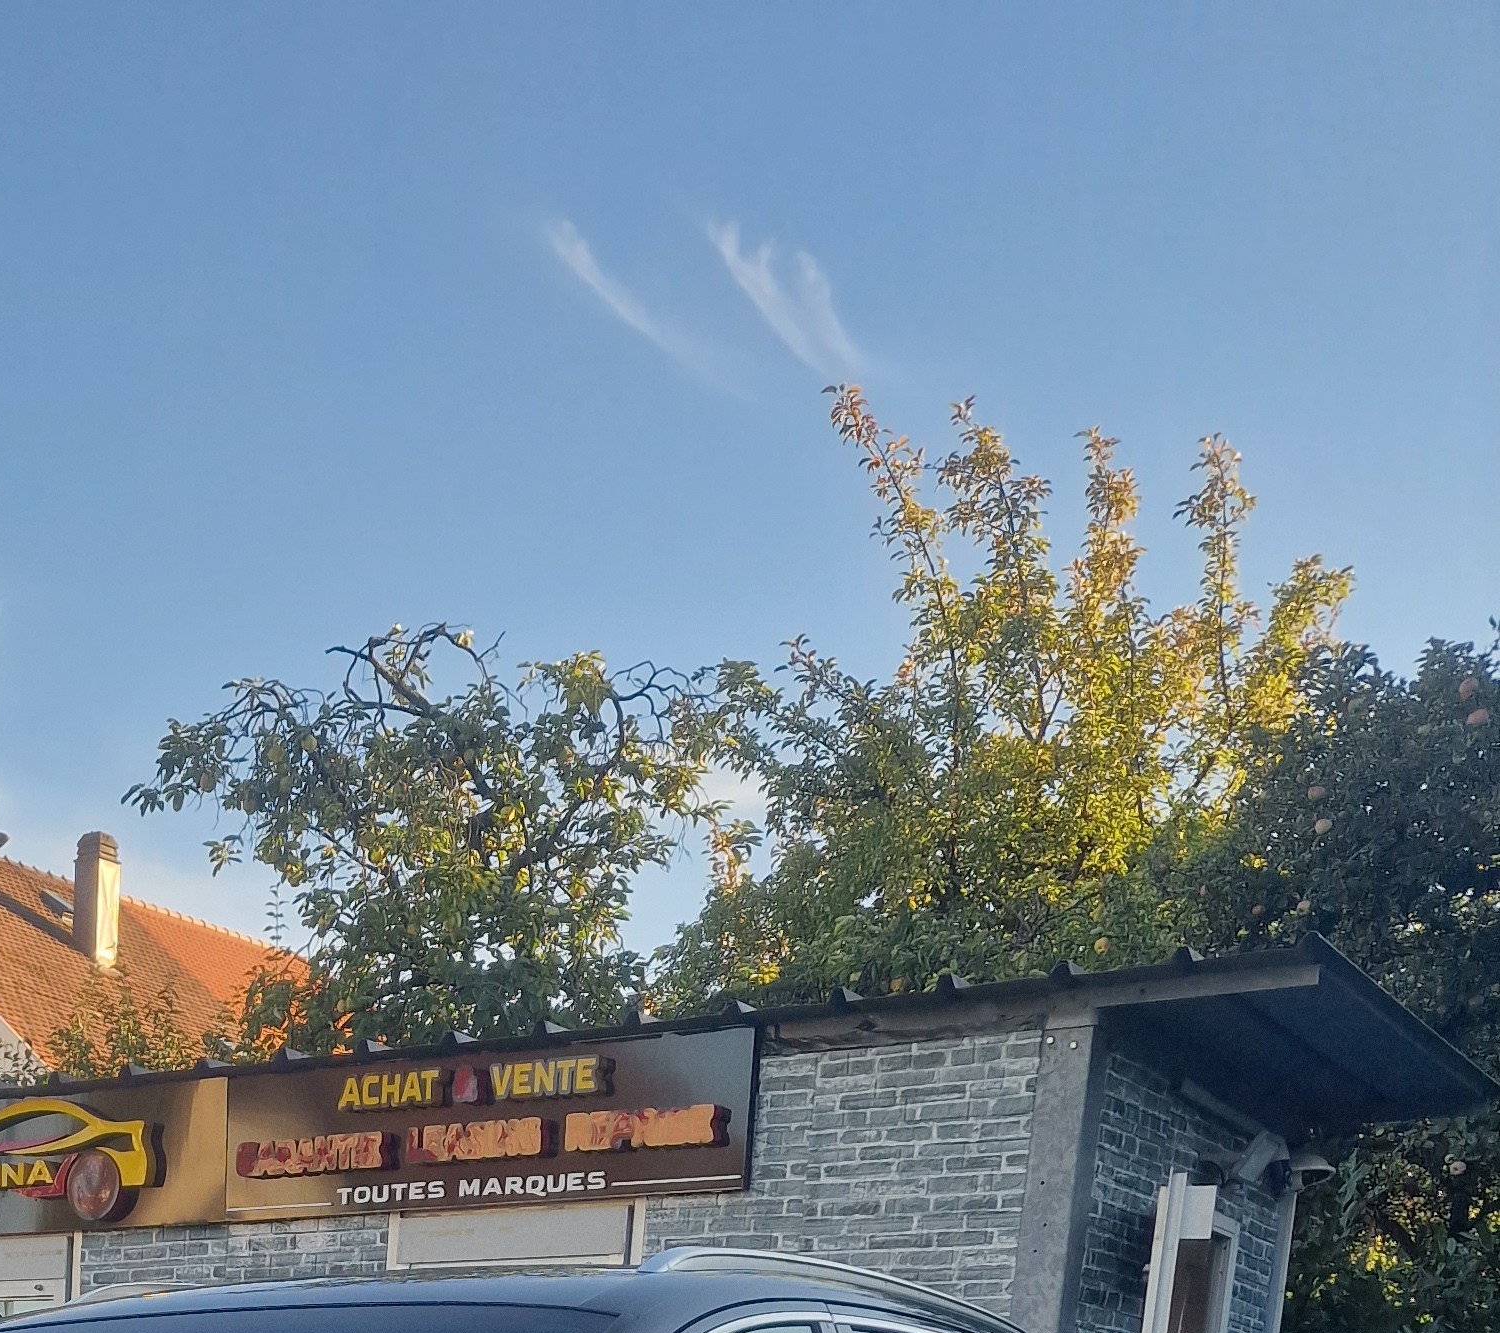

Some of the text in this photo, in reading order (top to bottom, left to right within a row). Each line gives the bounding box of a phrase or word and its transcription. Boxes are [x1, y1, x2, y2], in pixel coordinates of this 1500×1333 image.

[338, 1067, 440, 1111] ACHAT
[490, 1056, 599, 1099] VENTE
[337, 1171, 606, 1205] TOUTES MARQUES
